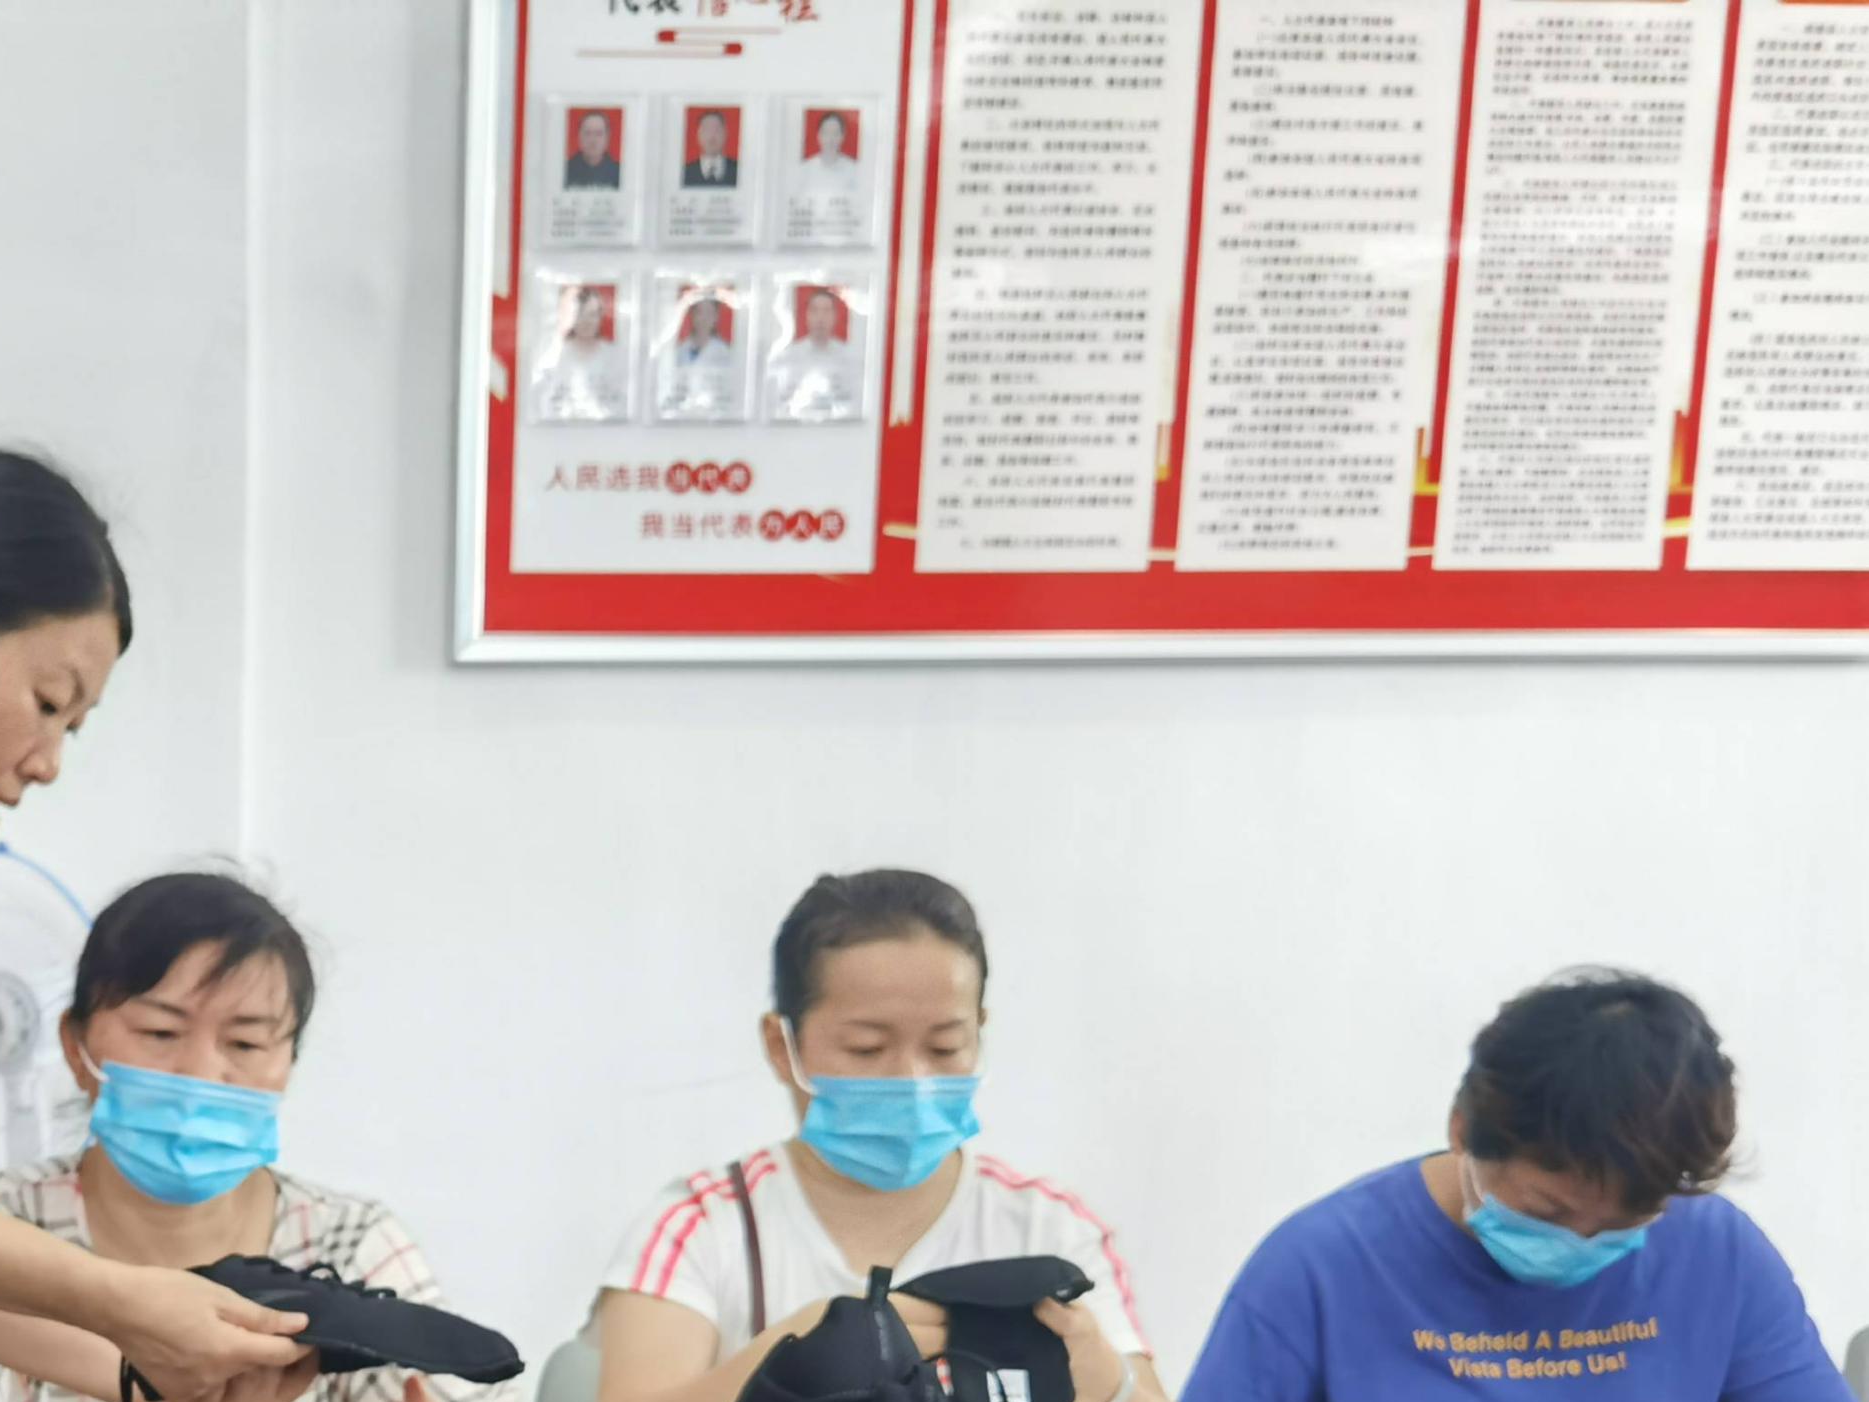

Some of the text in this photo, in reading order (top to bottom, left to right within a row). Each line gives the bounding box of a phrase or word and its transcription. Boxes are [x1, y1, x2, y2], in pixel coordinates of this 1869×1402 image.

[544, 461, 752, 494] 人民选我当代表
[640, 509, 846, 541] 我当代表为人民
[1412, 1316, 1660, 1353] We Behold A Beautiful
[1447, 1351, 1628, 1379] Vista Before Us!
